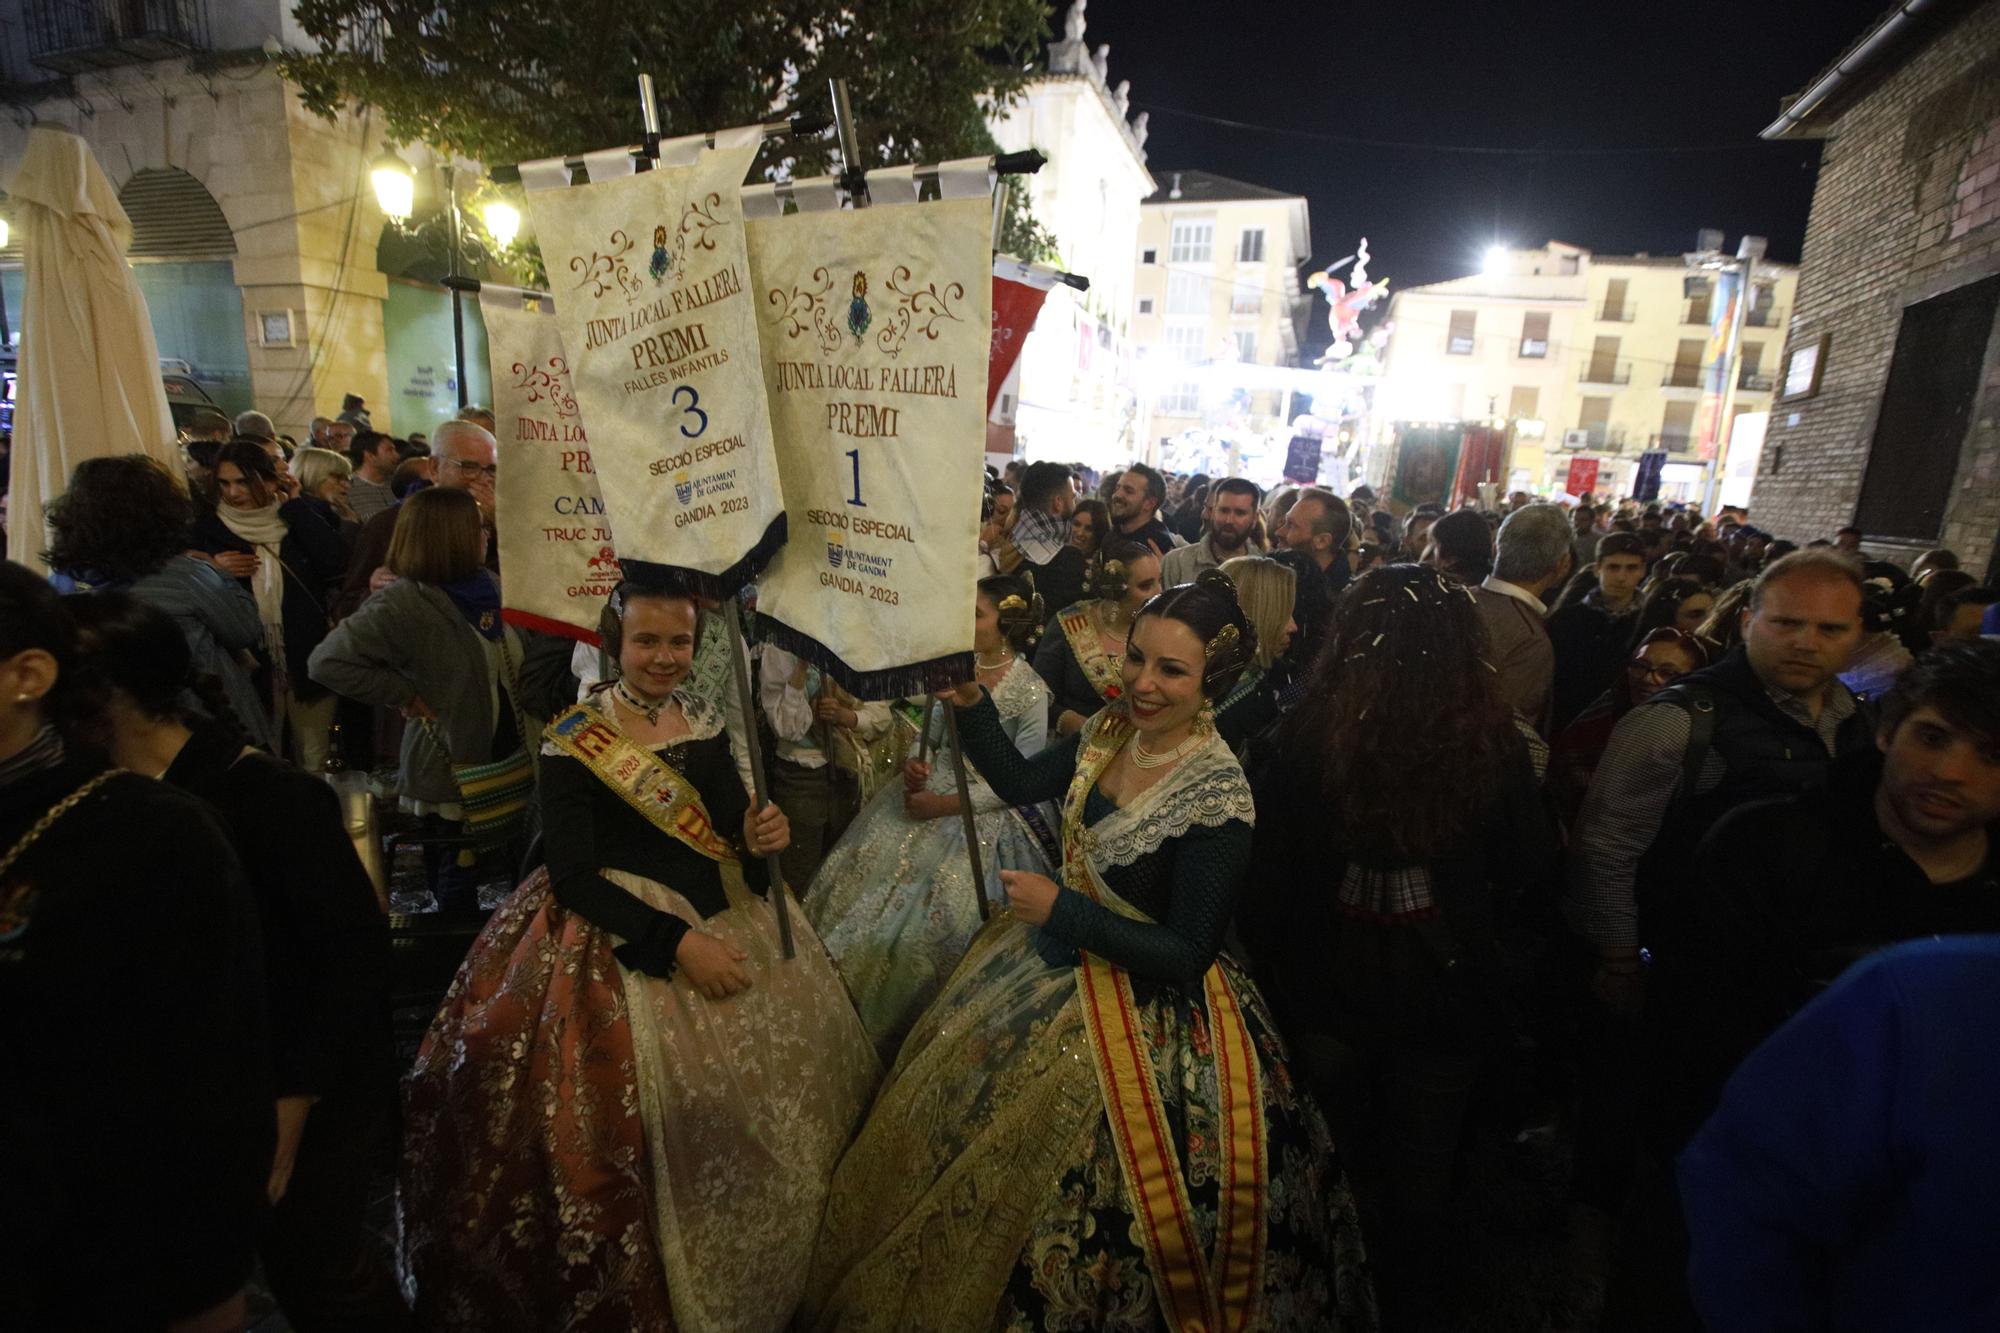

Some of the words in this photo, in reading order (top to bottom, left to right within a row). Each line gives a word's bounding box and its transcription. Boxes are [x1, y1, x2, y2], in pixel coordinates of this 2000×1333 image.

[585, 317, 627, 351] JUNTA
[630, 299, 671, 333] LOCAL
[670, 263, 743, 314] FALLERA
[630, 322, 710, 370] PREMI
[623, 371, 669, 395] FALLES
[669, 350, 730, 381] INFANTILS
[776, 361, 825, 393] JUNTA
[827, 364, 874, 391] LOCAL
[879, 363, 958, 399] FALLERA
[672, 385, 708, 438] 3
[825, 402, 900, 438] PREMI
[516, 417, 559, 442] JUNTA
[649, 449, 692, 476] SECCIÓ
[695, 433, 746, 462] ESPECIAL
[692, 468, 737, 490] AJUNTAMENT
[696, 486, 705, 498] DE
[706, 480, 735, 495] GANDIA
[845, 448, 867, 507] 1
[674, 504, 716, 528] GANDIA
[720, 496, 749, 514] 2023
[807, 509, 849, 530] SECCIÓ
[853, 517, 915, 543] ESPECIAL
[542, 527, 586, 542] TRUC
[844, 549, 893, 567] AJUNTAMENT
[846, 560, 857, 570] DE
[858, 564, 887, 578] GANDIA
[820, 571, 864, 596] GANDIA
[869, 585, 899, 606] 2023
[618, 755, 641, 779] 2023
